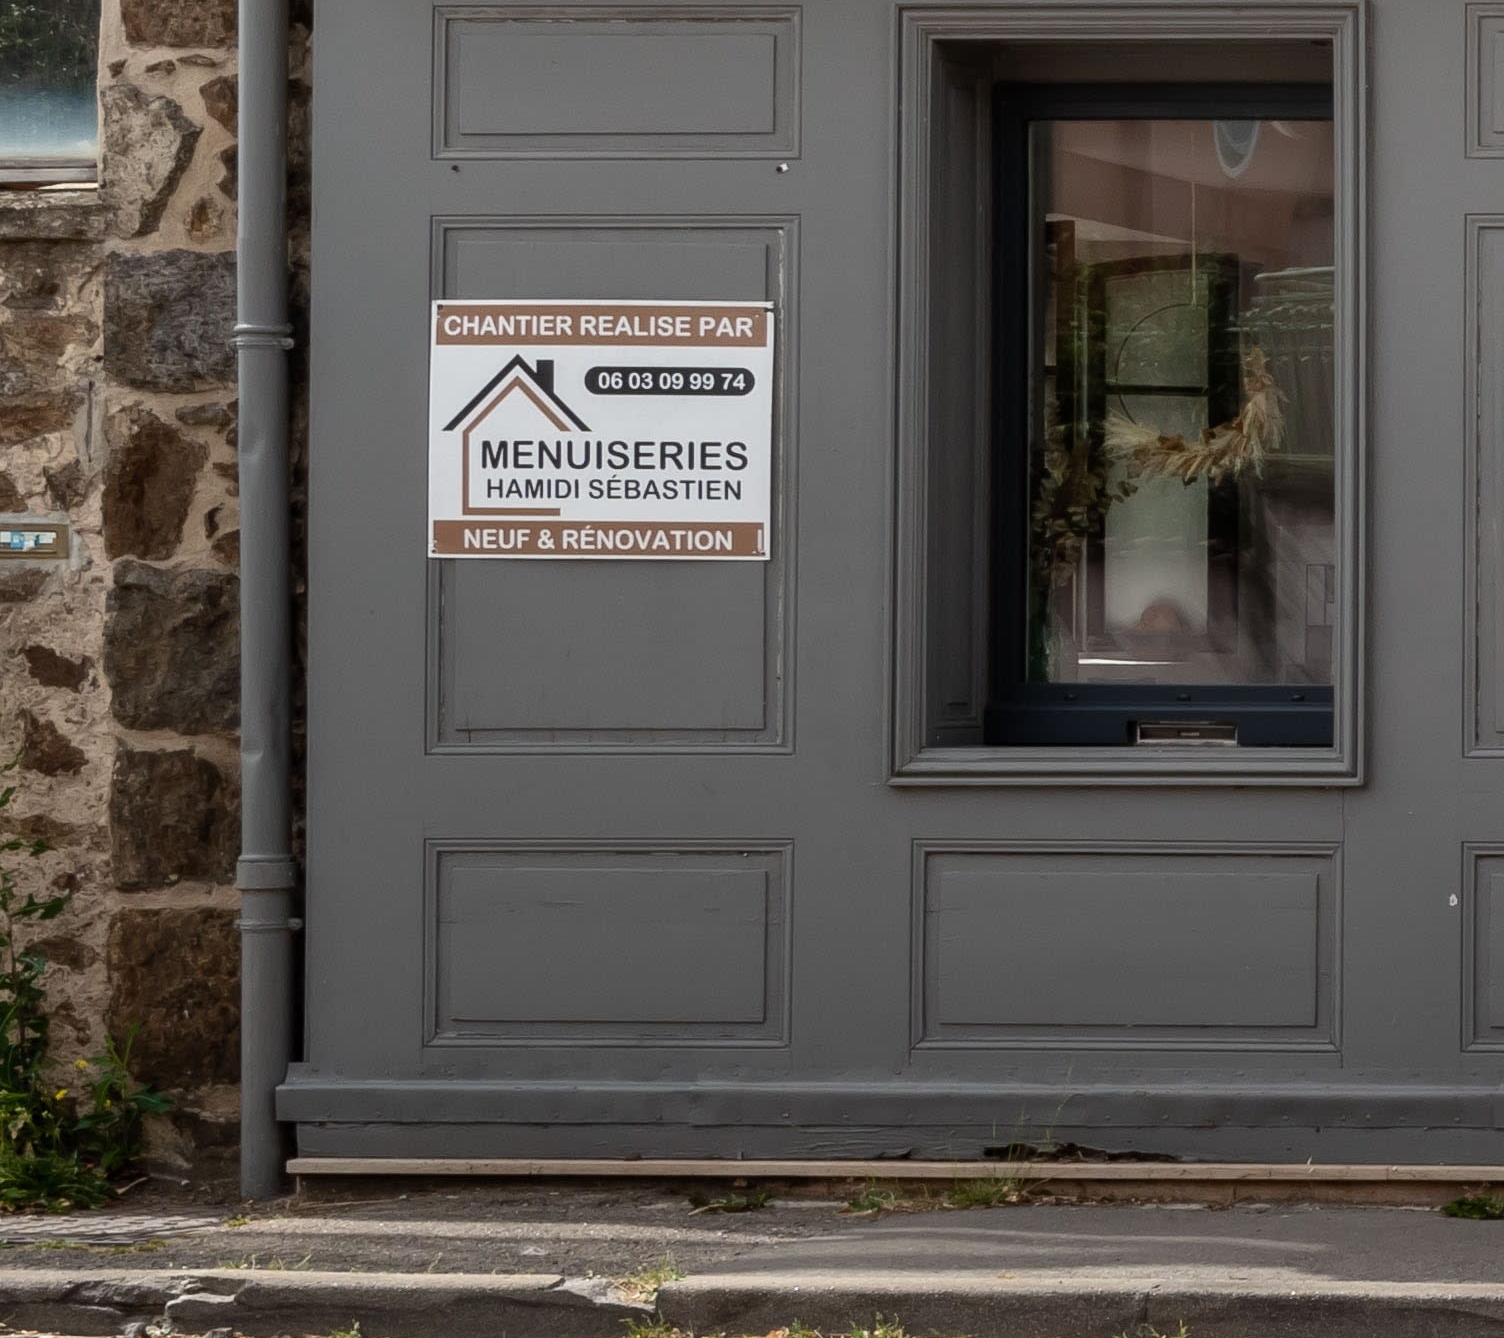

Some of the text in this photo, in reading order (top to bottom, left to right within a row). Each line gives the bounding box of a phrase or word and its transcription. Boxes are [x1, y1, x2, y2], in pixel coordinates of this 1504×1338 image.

[443, 314, 754, 338] CHANTIER REALISE PAR
[597, 372, 746, 391] 06 03 09 99 74
[480, 440, 749, 471] MENUISERIES
[486, 474, 742, 500] HAMIDI SÉBASTIEN
[463, 525, 733, 551] NEUF & RÉNOVATION
